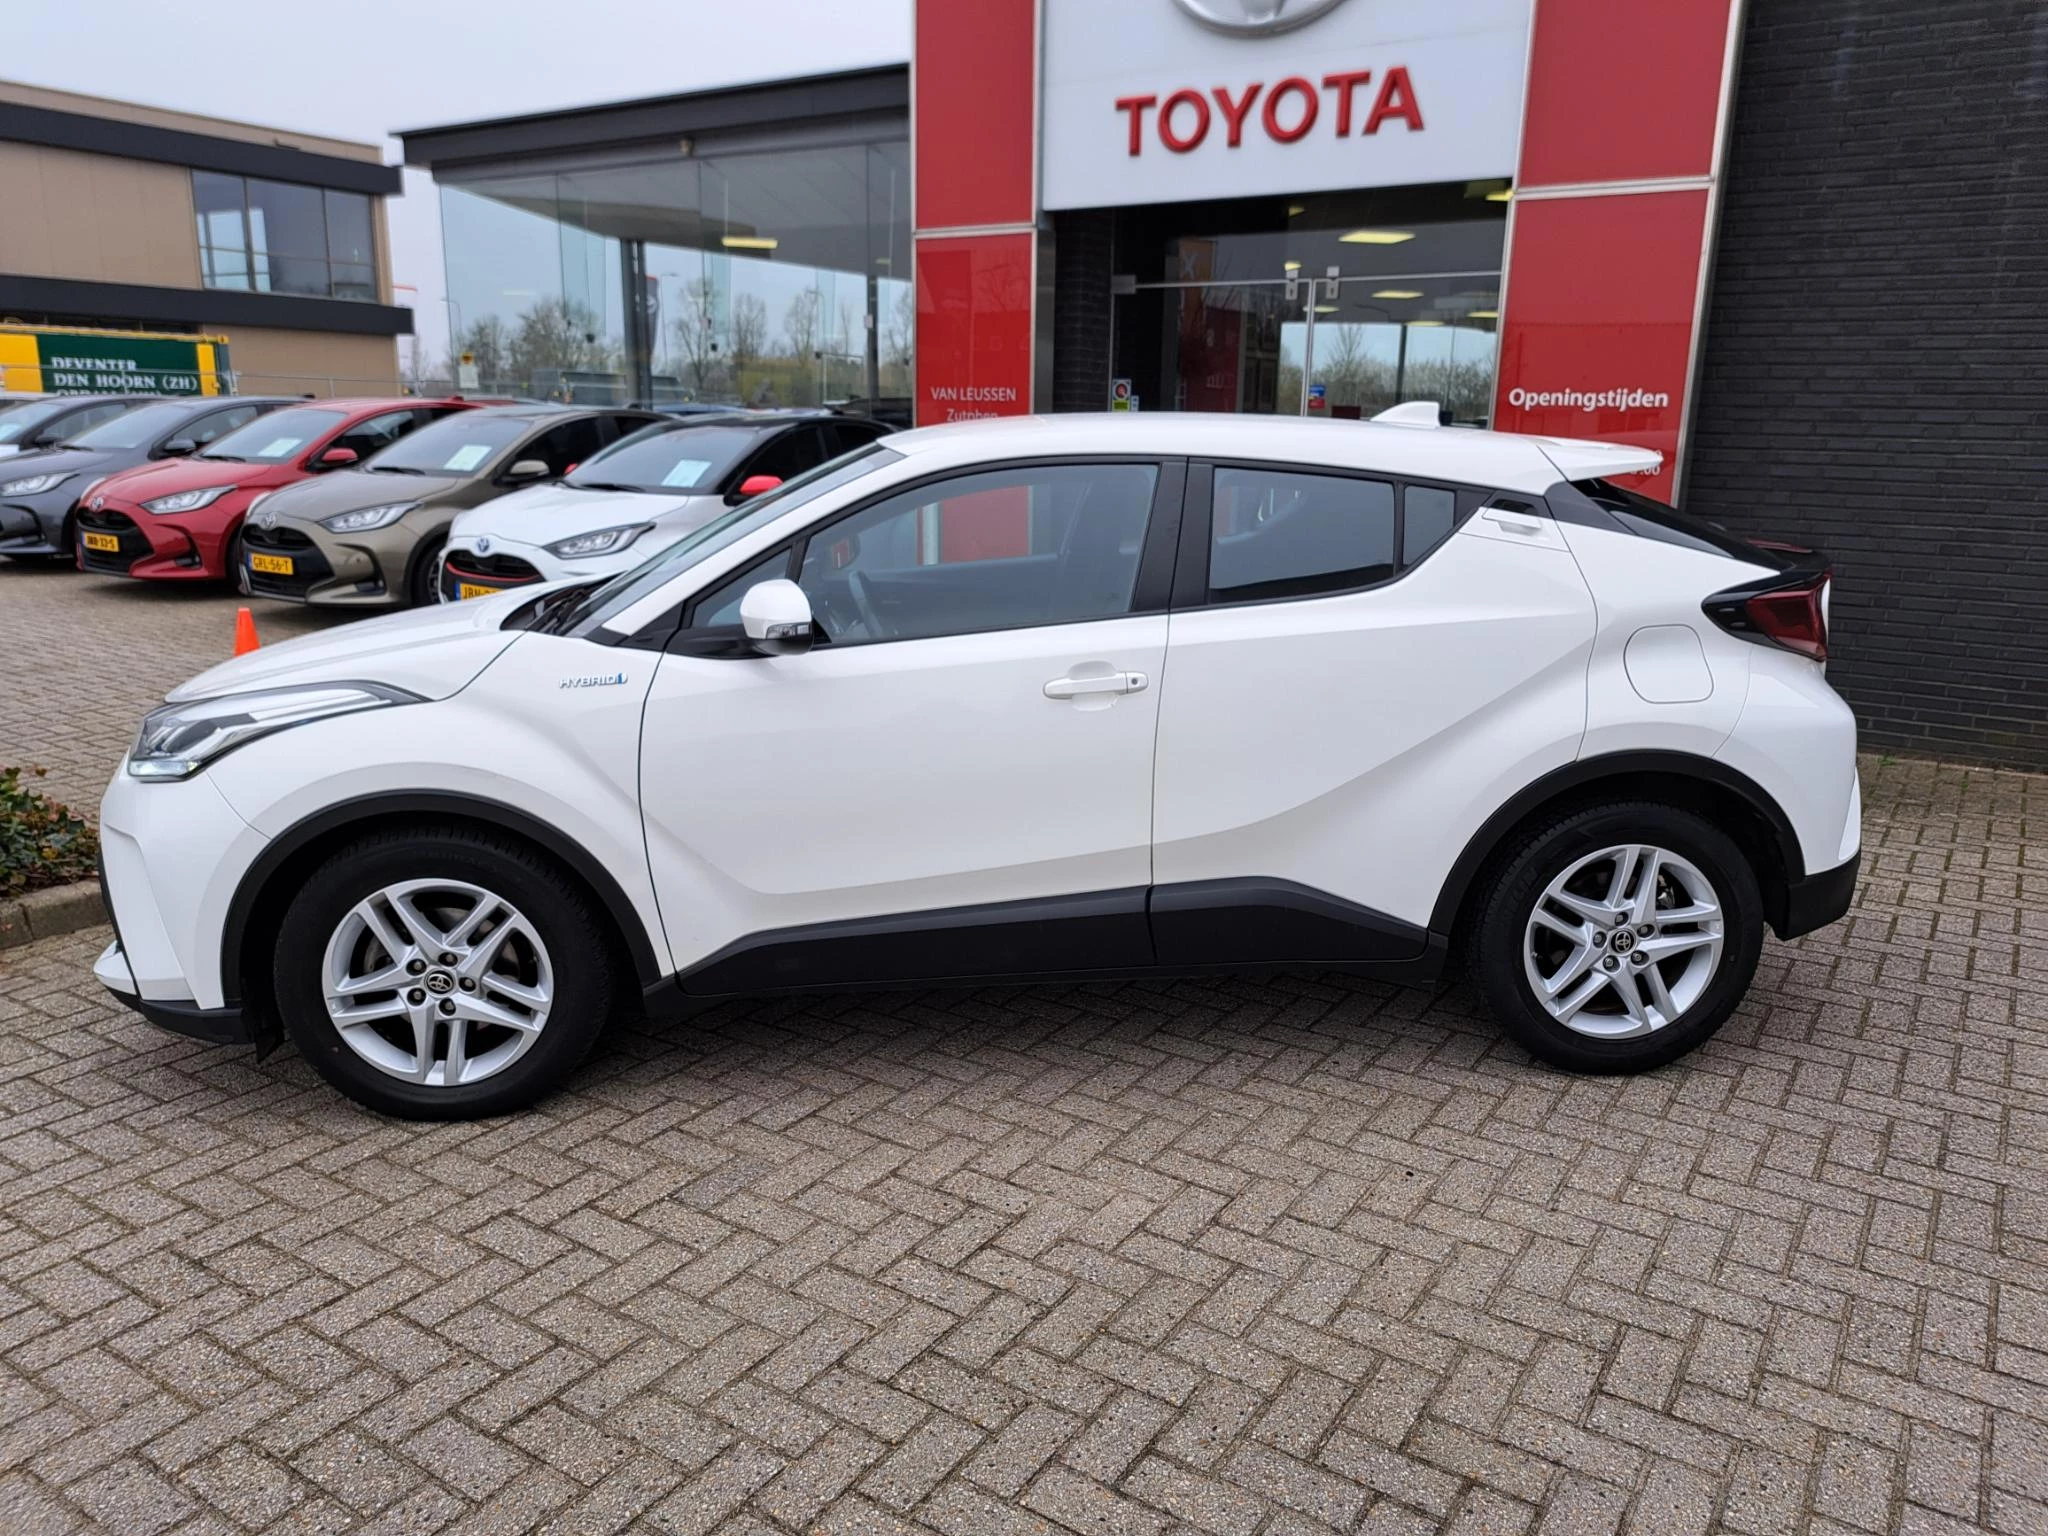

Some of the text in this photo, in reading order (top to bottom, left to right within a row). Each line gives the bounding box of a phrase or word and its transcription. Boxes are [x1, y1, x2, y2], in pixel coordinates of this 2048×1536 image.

[1115, 65, 1425, 157] TOYOTA
[50, 356, 136, 371] DEVENTER
[53, 373, 198, 391] DEN HOORN (ZH)
[930, 387, 1016, 401] VAN LEUSSEN
[1509, 388, 1669, 412] Openingstijden
[559, 673, 617, 689] HYBRID
